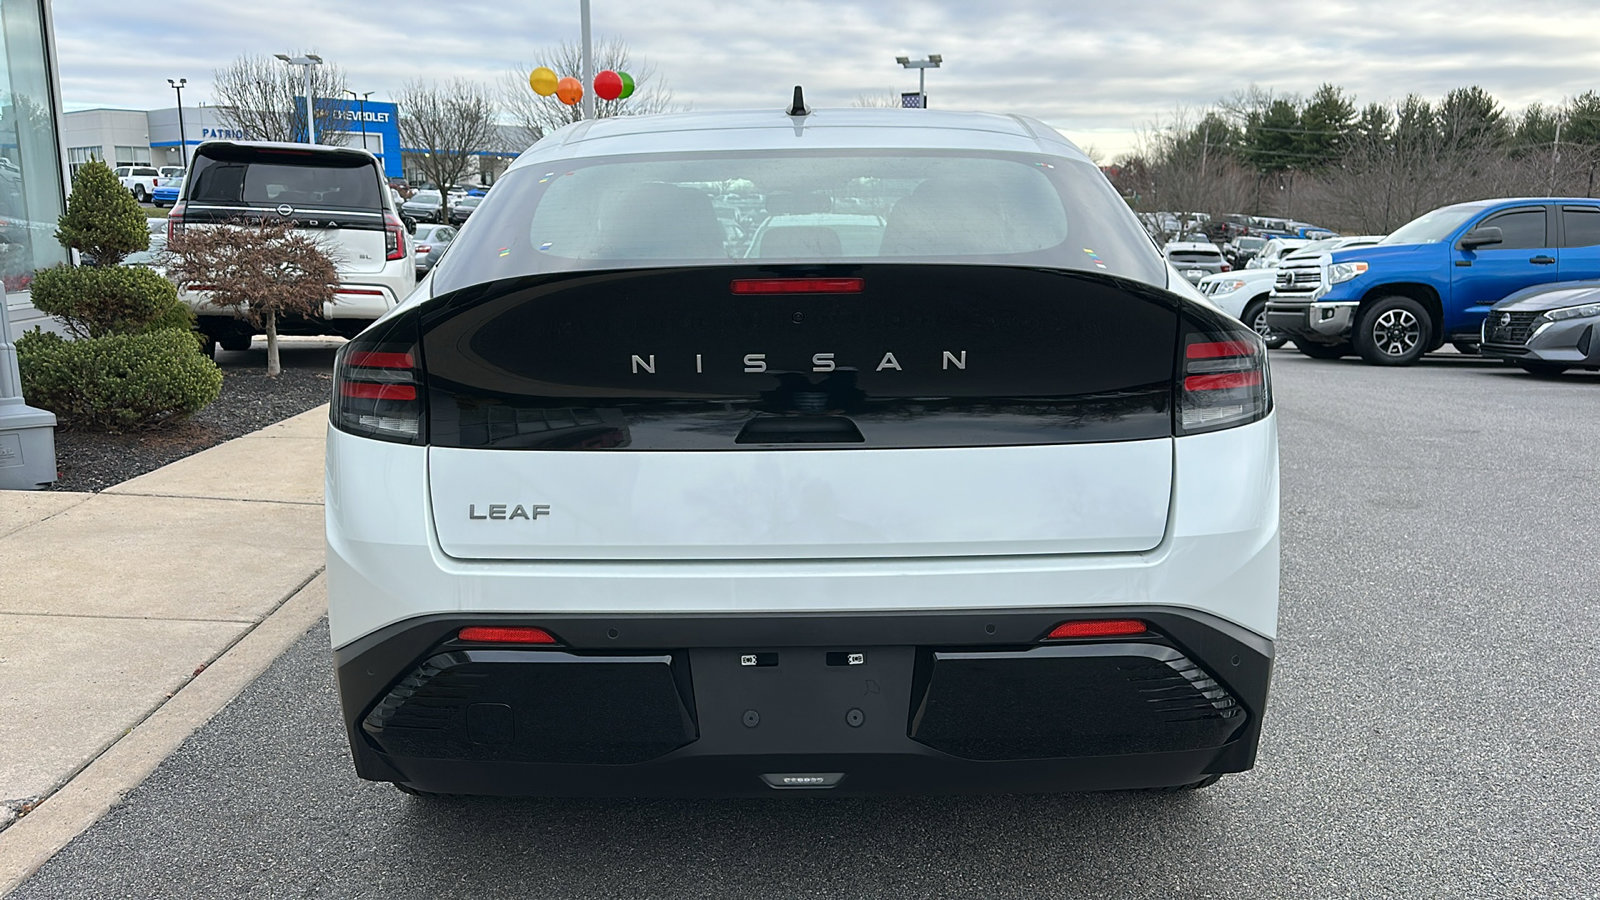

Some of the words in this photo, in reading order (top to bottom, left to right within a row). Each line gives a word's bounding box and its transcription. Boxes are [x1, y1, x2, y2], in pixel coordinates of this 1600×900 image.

[333, 109, 389, 123] CHEVROLET
[203, 128, 247, 139] PATRIO
[631, 350, 966, 374] NISSAN
[469, 504, 550, 520] LEAF
